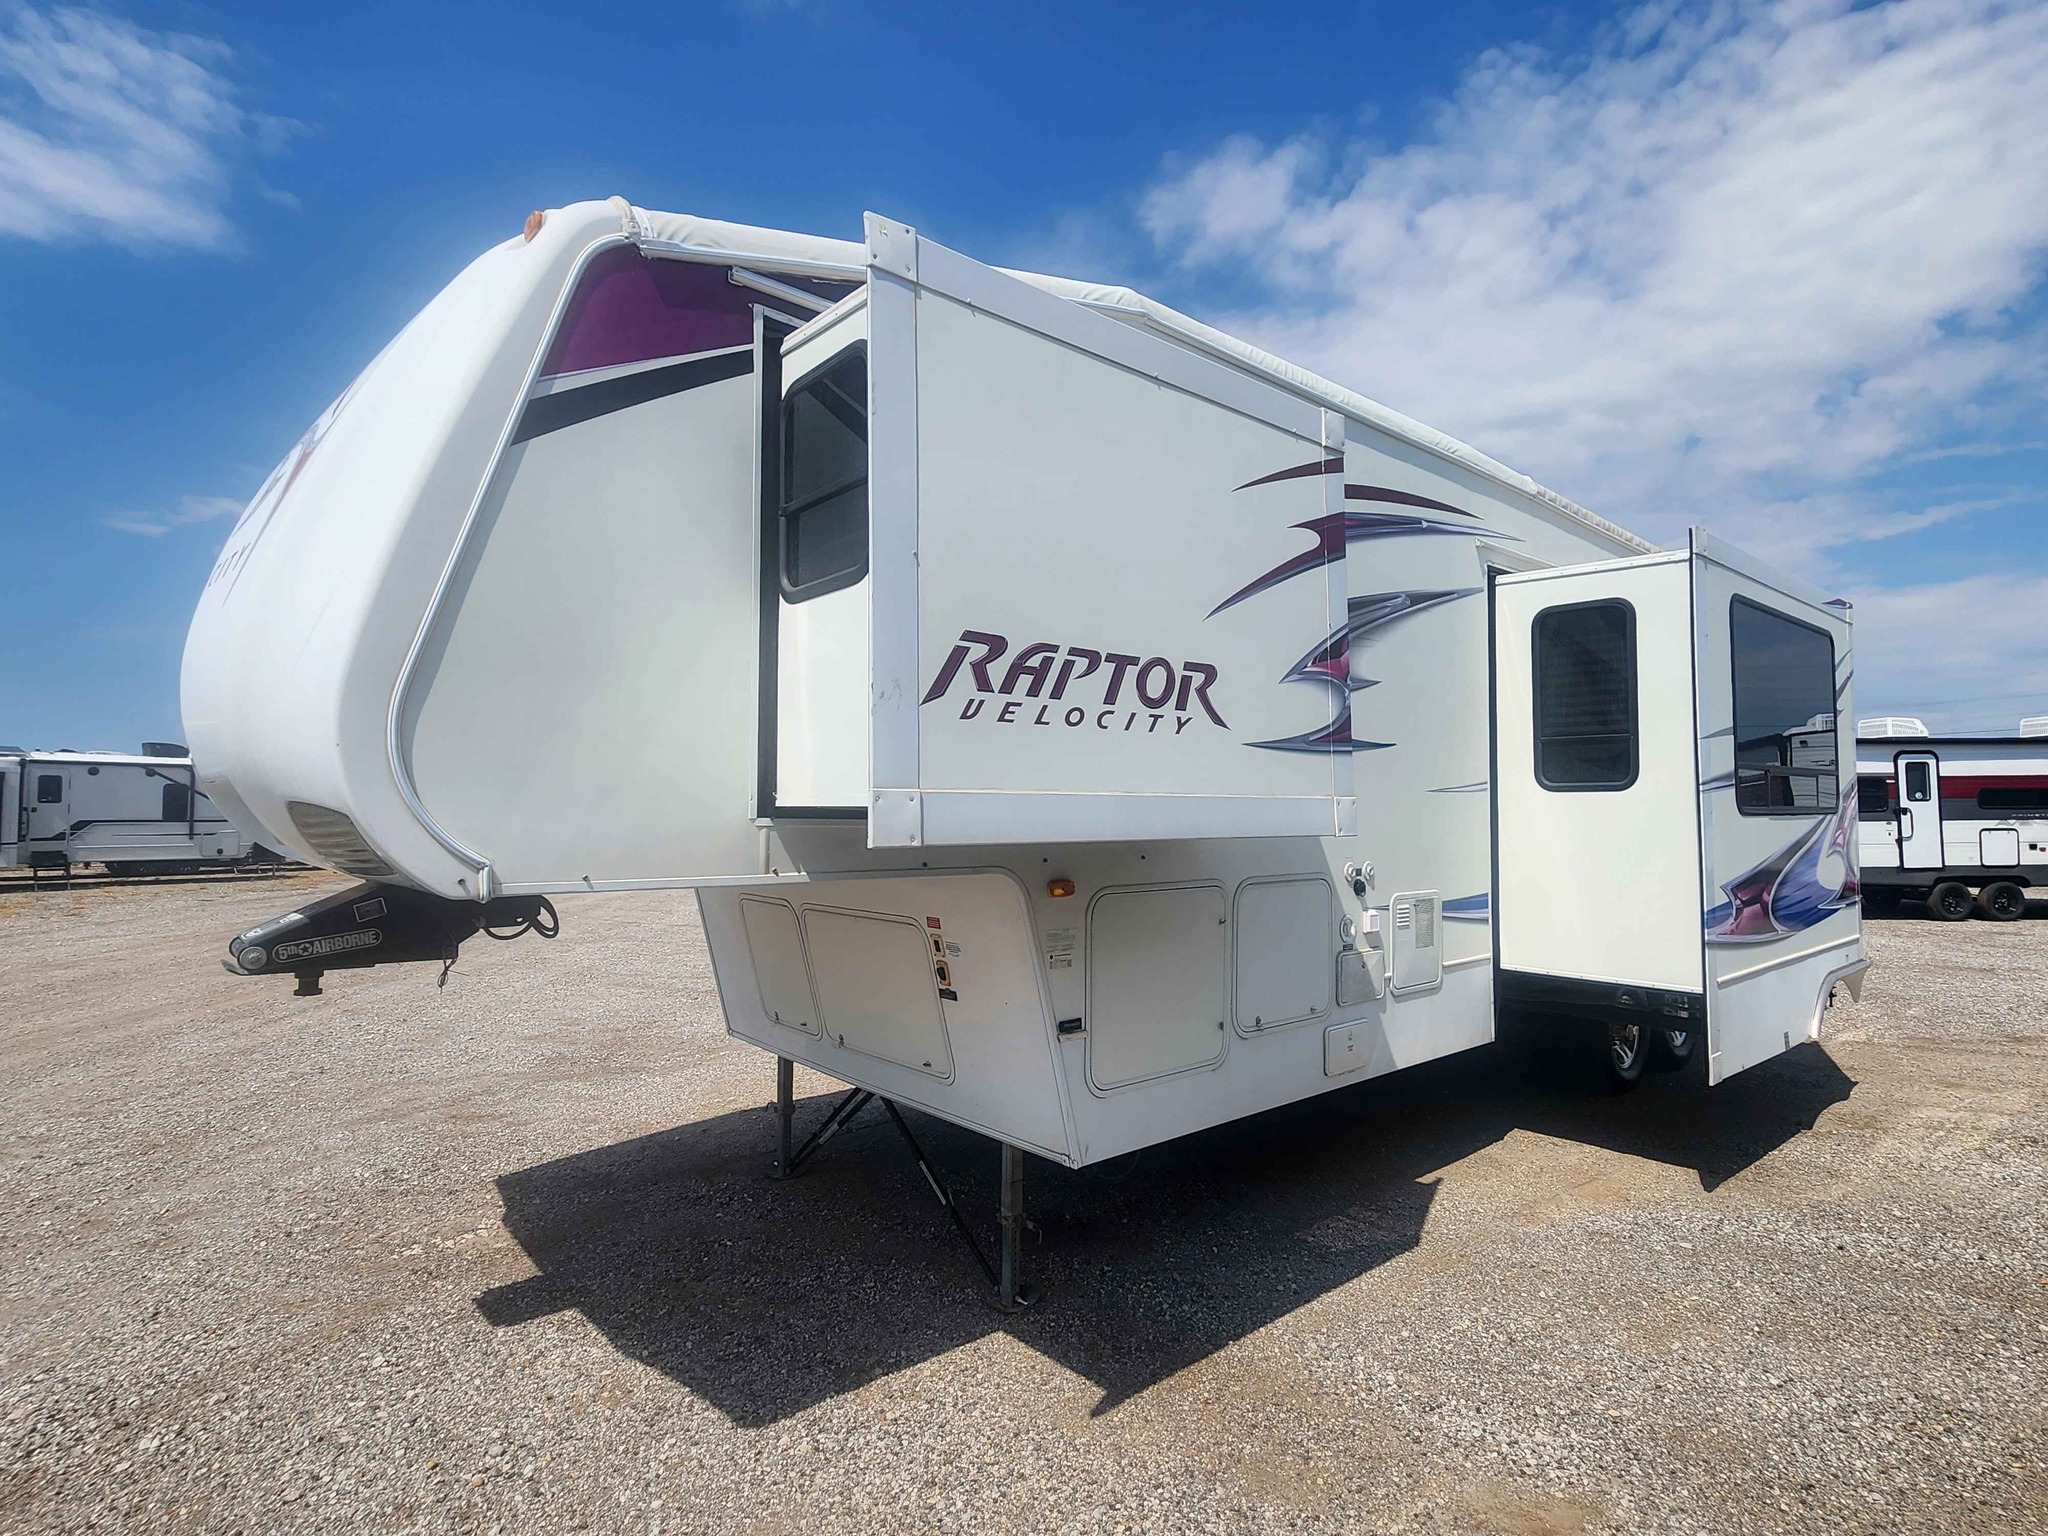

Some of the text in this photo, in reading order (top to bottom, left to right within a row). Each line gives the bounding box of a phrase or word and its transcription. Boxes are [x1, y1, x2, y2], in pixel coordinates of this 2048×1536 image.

[918, 629, 1232, 731] RAPTOR
[958, 698, 1194, 735] VELOCITY
[278, 931, 377, 960] 5th AIRBORNE
